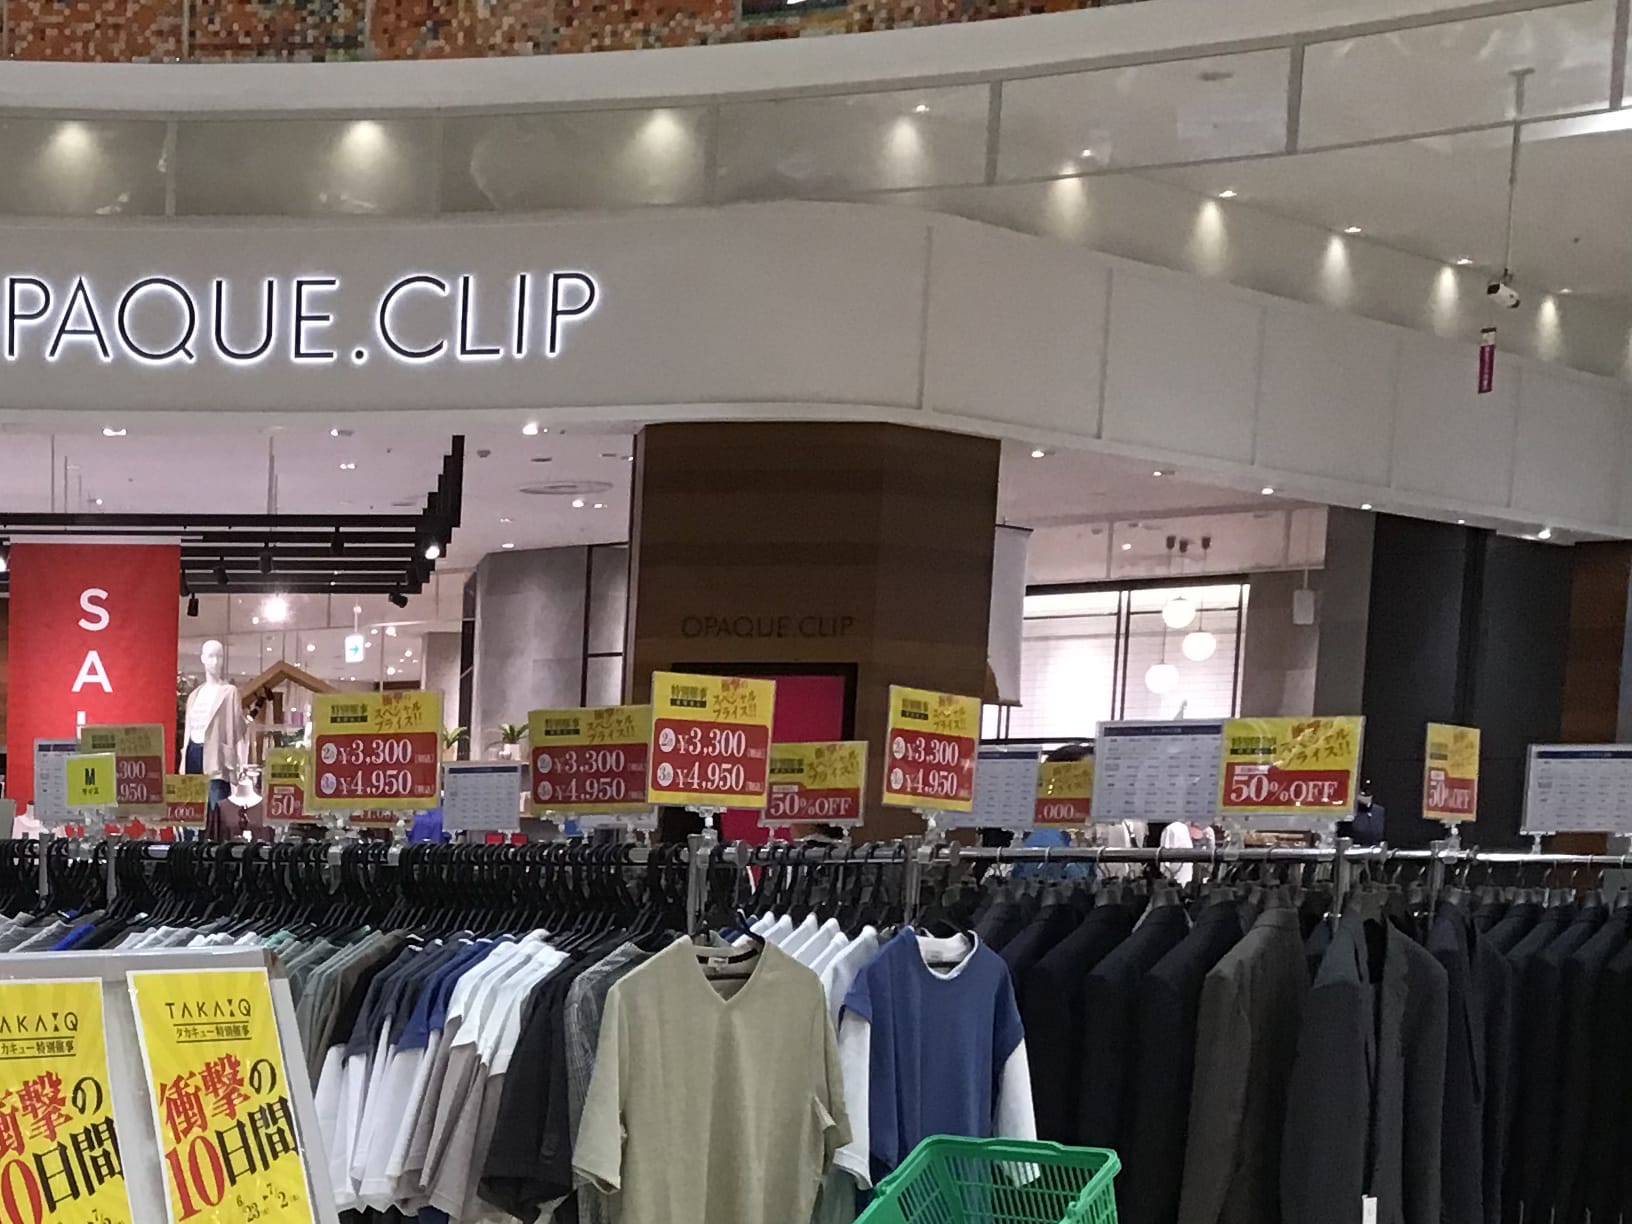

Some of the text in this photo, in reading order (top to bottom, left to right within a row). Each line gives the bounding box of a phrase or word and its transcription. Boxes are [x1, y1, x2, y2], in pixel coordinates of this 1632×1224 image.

[84, 768, 96, 786] M
[159, 1052, 277, 1145] 衝撃の
[164, 1095, 300, 1223] 10日間
